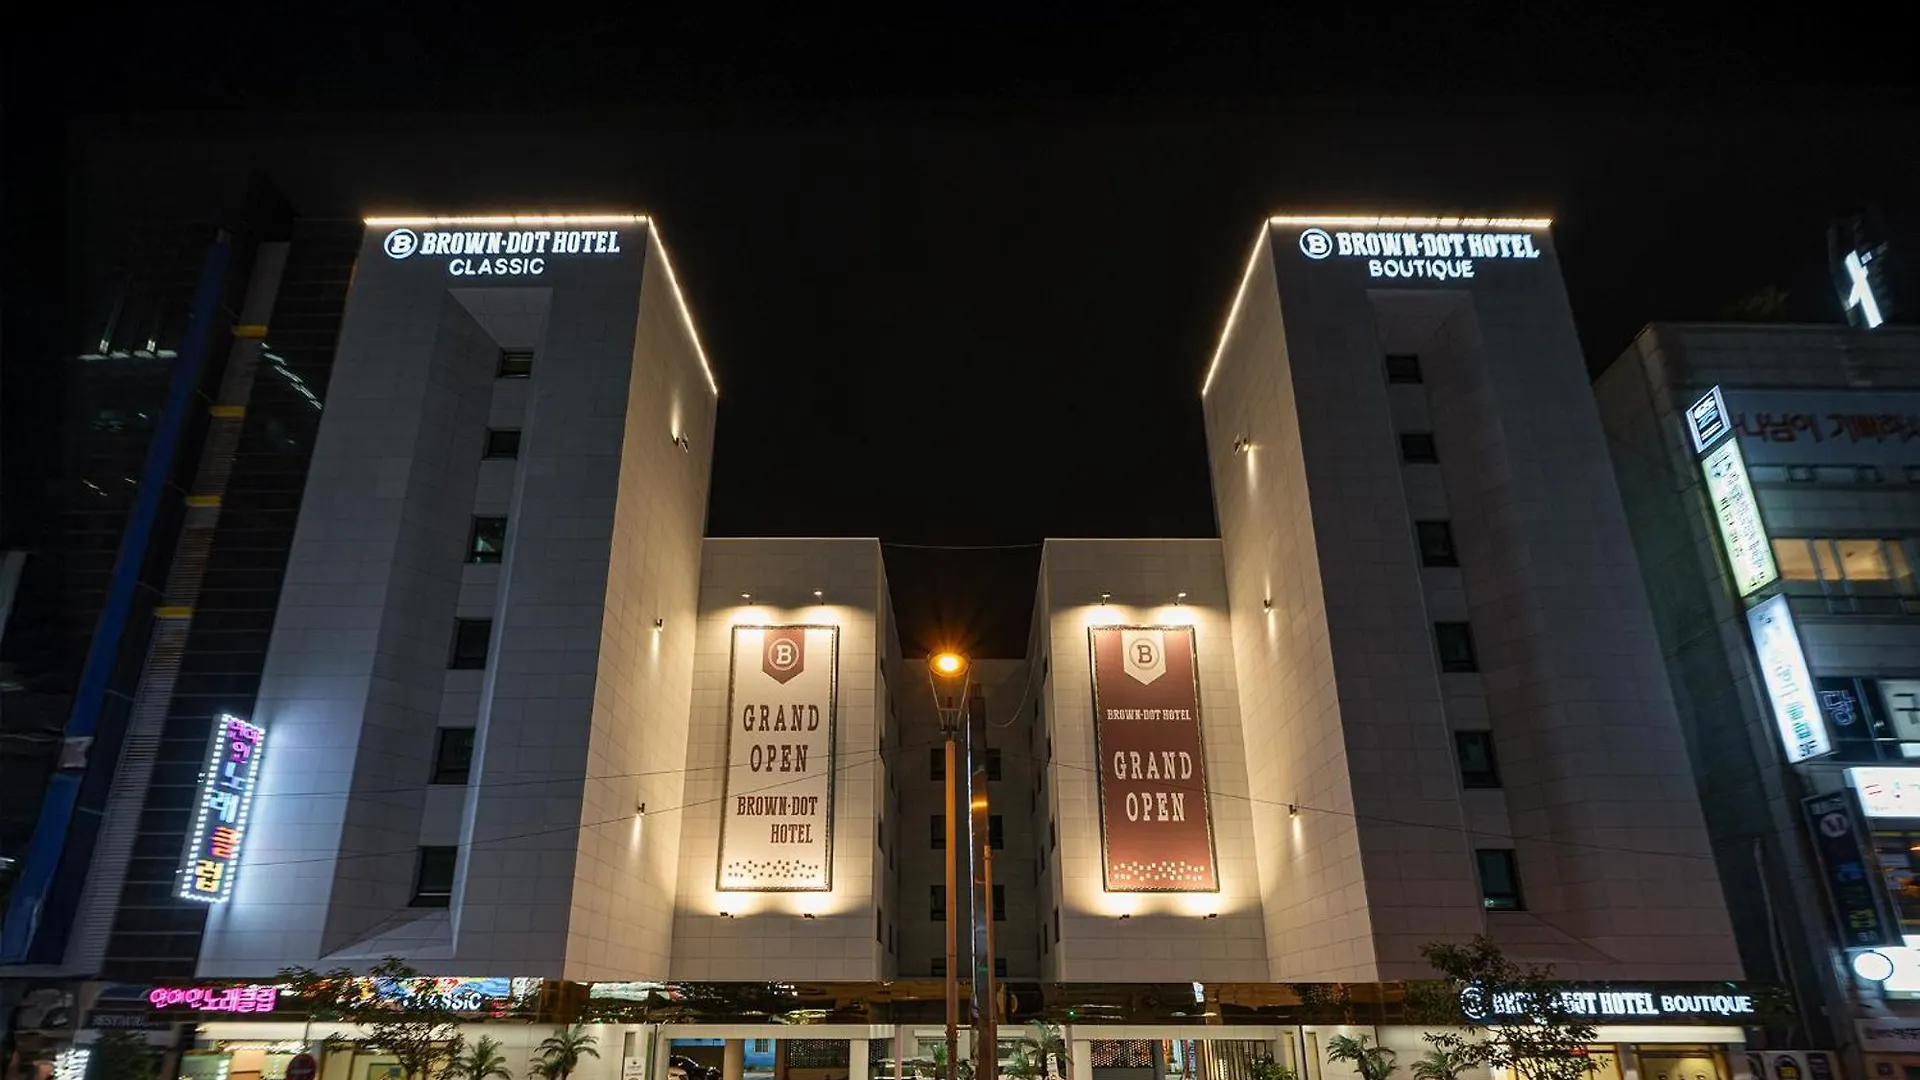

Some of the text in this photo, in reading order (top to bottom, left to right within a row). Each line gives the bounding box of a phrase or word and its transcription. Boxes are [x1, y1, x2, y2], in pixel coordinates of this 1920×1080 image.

[552, 231, 620, 253] HOTEL
[1468, 233, 1540, 258] HOTEL
[449, 258, 545, 276] CLASSIC
[1368, 259, 1475, 280] BOUTIQUE
[743, 704, 819, 732] GRAND
[1162, 709, 1191, 721] HOTEL
[750, 745, 808, 772] OPEN
[1113, 751, 1193, 780] GRAND
[1125, 792, 1185, 822] OPEN
[770, 824, 813, 844] HOTEL
[1600, 992, 1659, 1015] HOTEL
[1662, 995, 1754, 1015] BOUTIQUE
